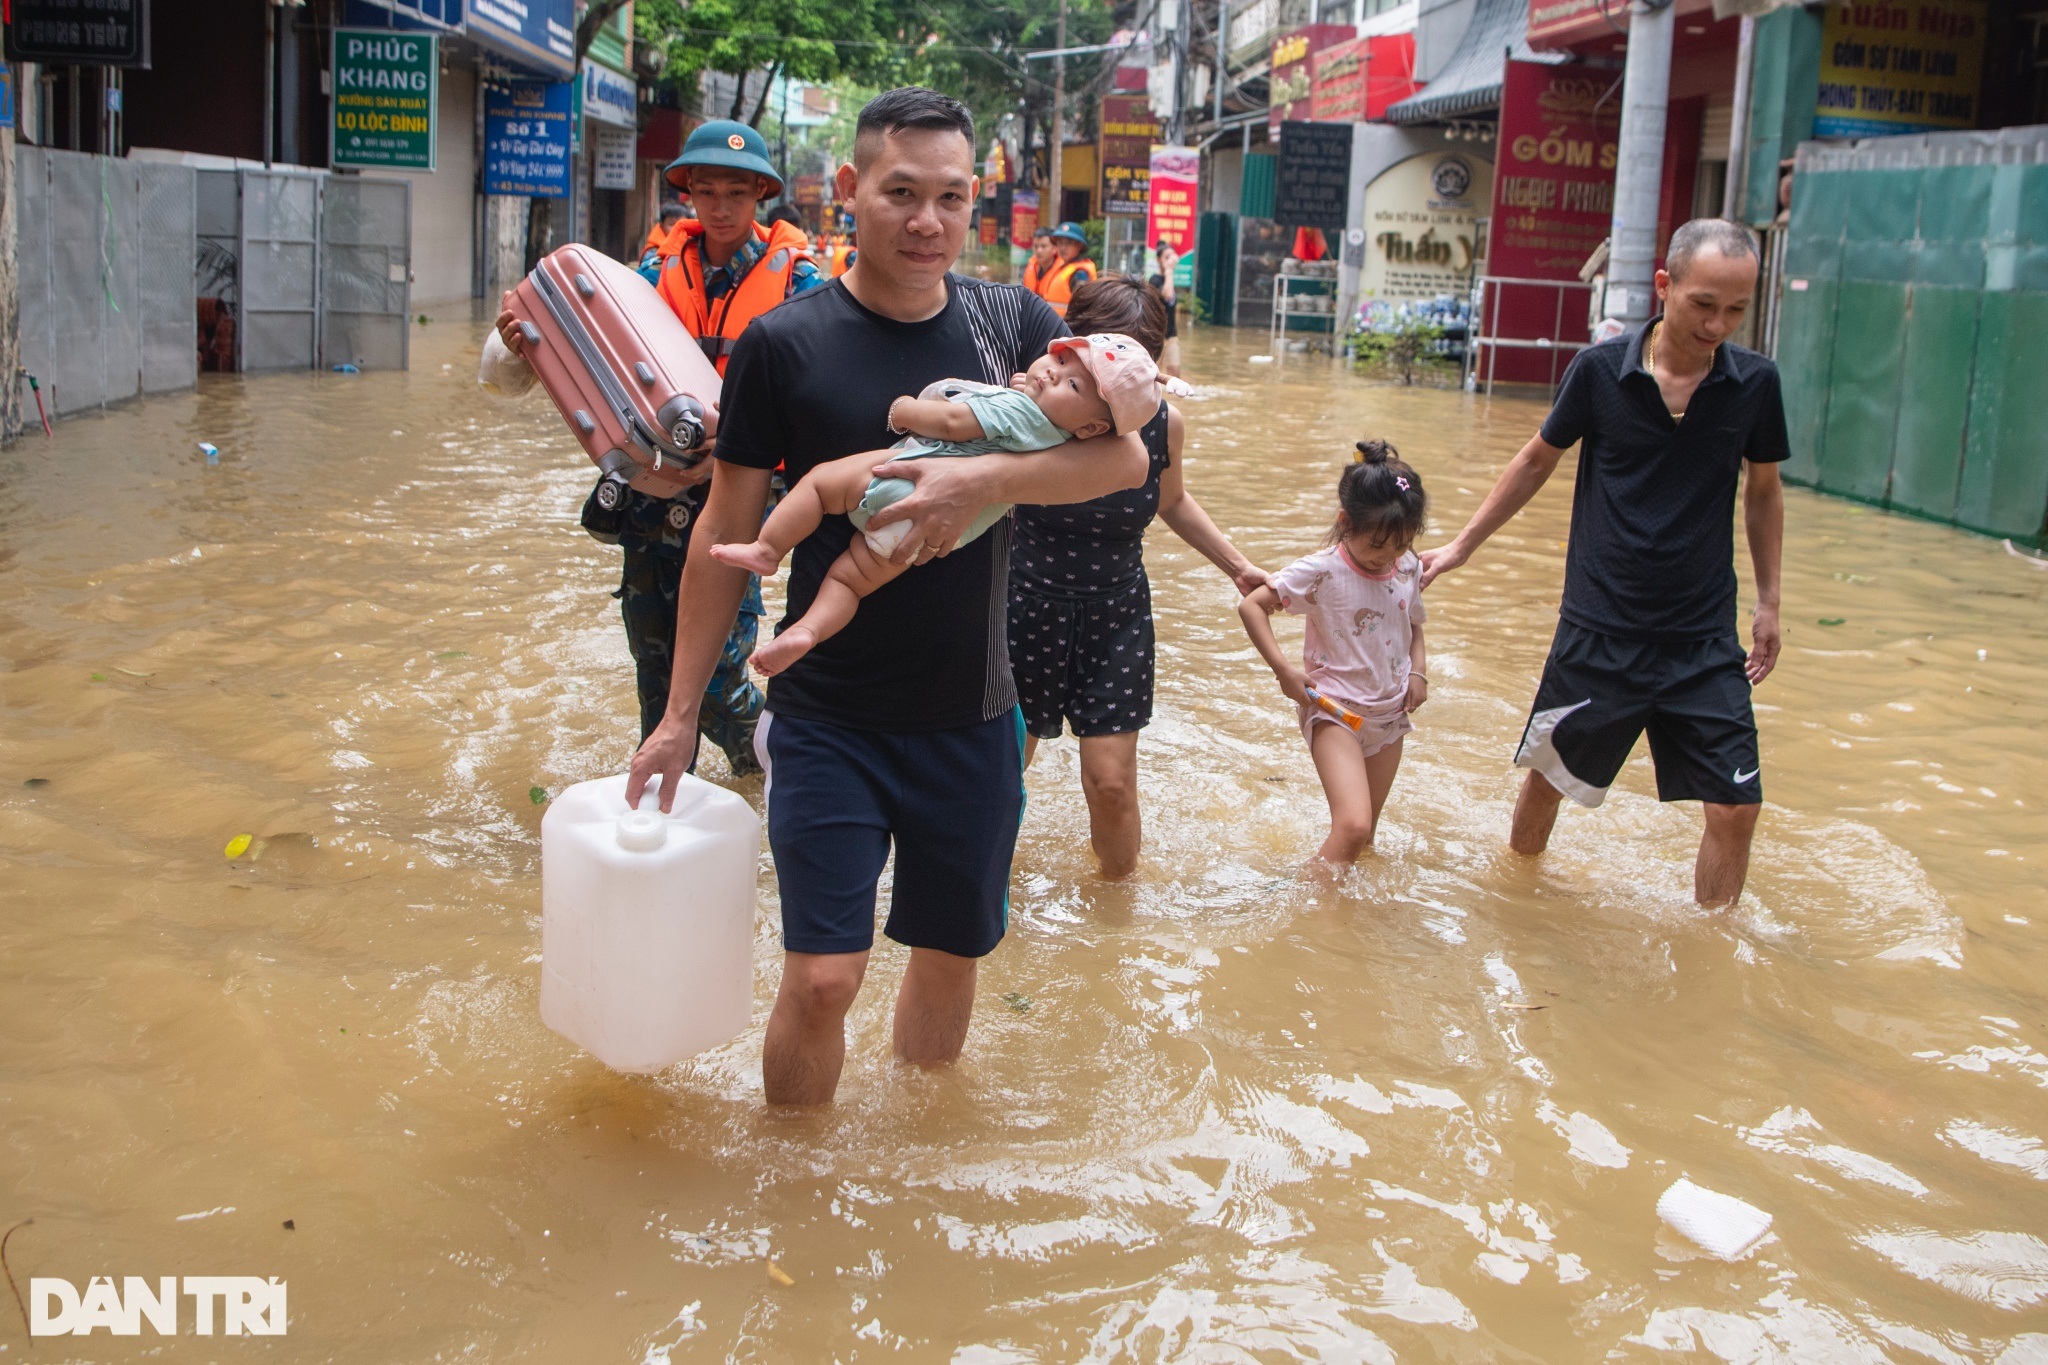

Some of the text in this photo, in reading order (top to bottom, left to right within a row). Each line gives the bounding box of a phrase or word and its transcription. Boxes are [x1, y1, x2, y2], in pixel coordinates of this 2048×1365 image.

[339, 67, 427, 92] KHANG
[1818, 84, 1856, 109] HONG
[337, 110, 427, 133] LỌ LỘC BÌNH
[505, 120, 550, 137] Số 1
[1511, 124, 1617, 170] GỐM S
[1376, 226, 1451, 266] Tuấn
